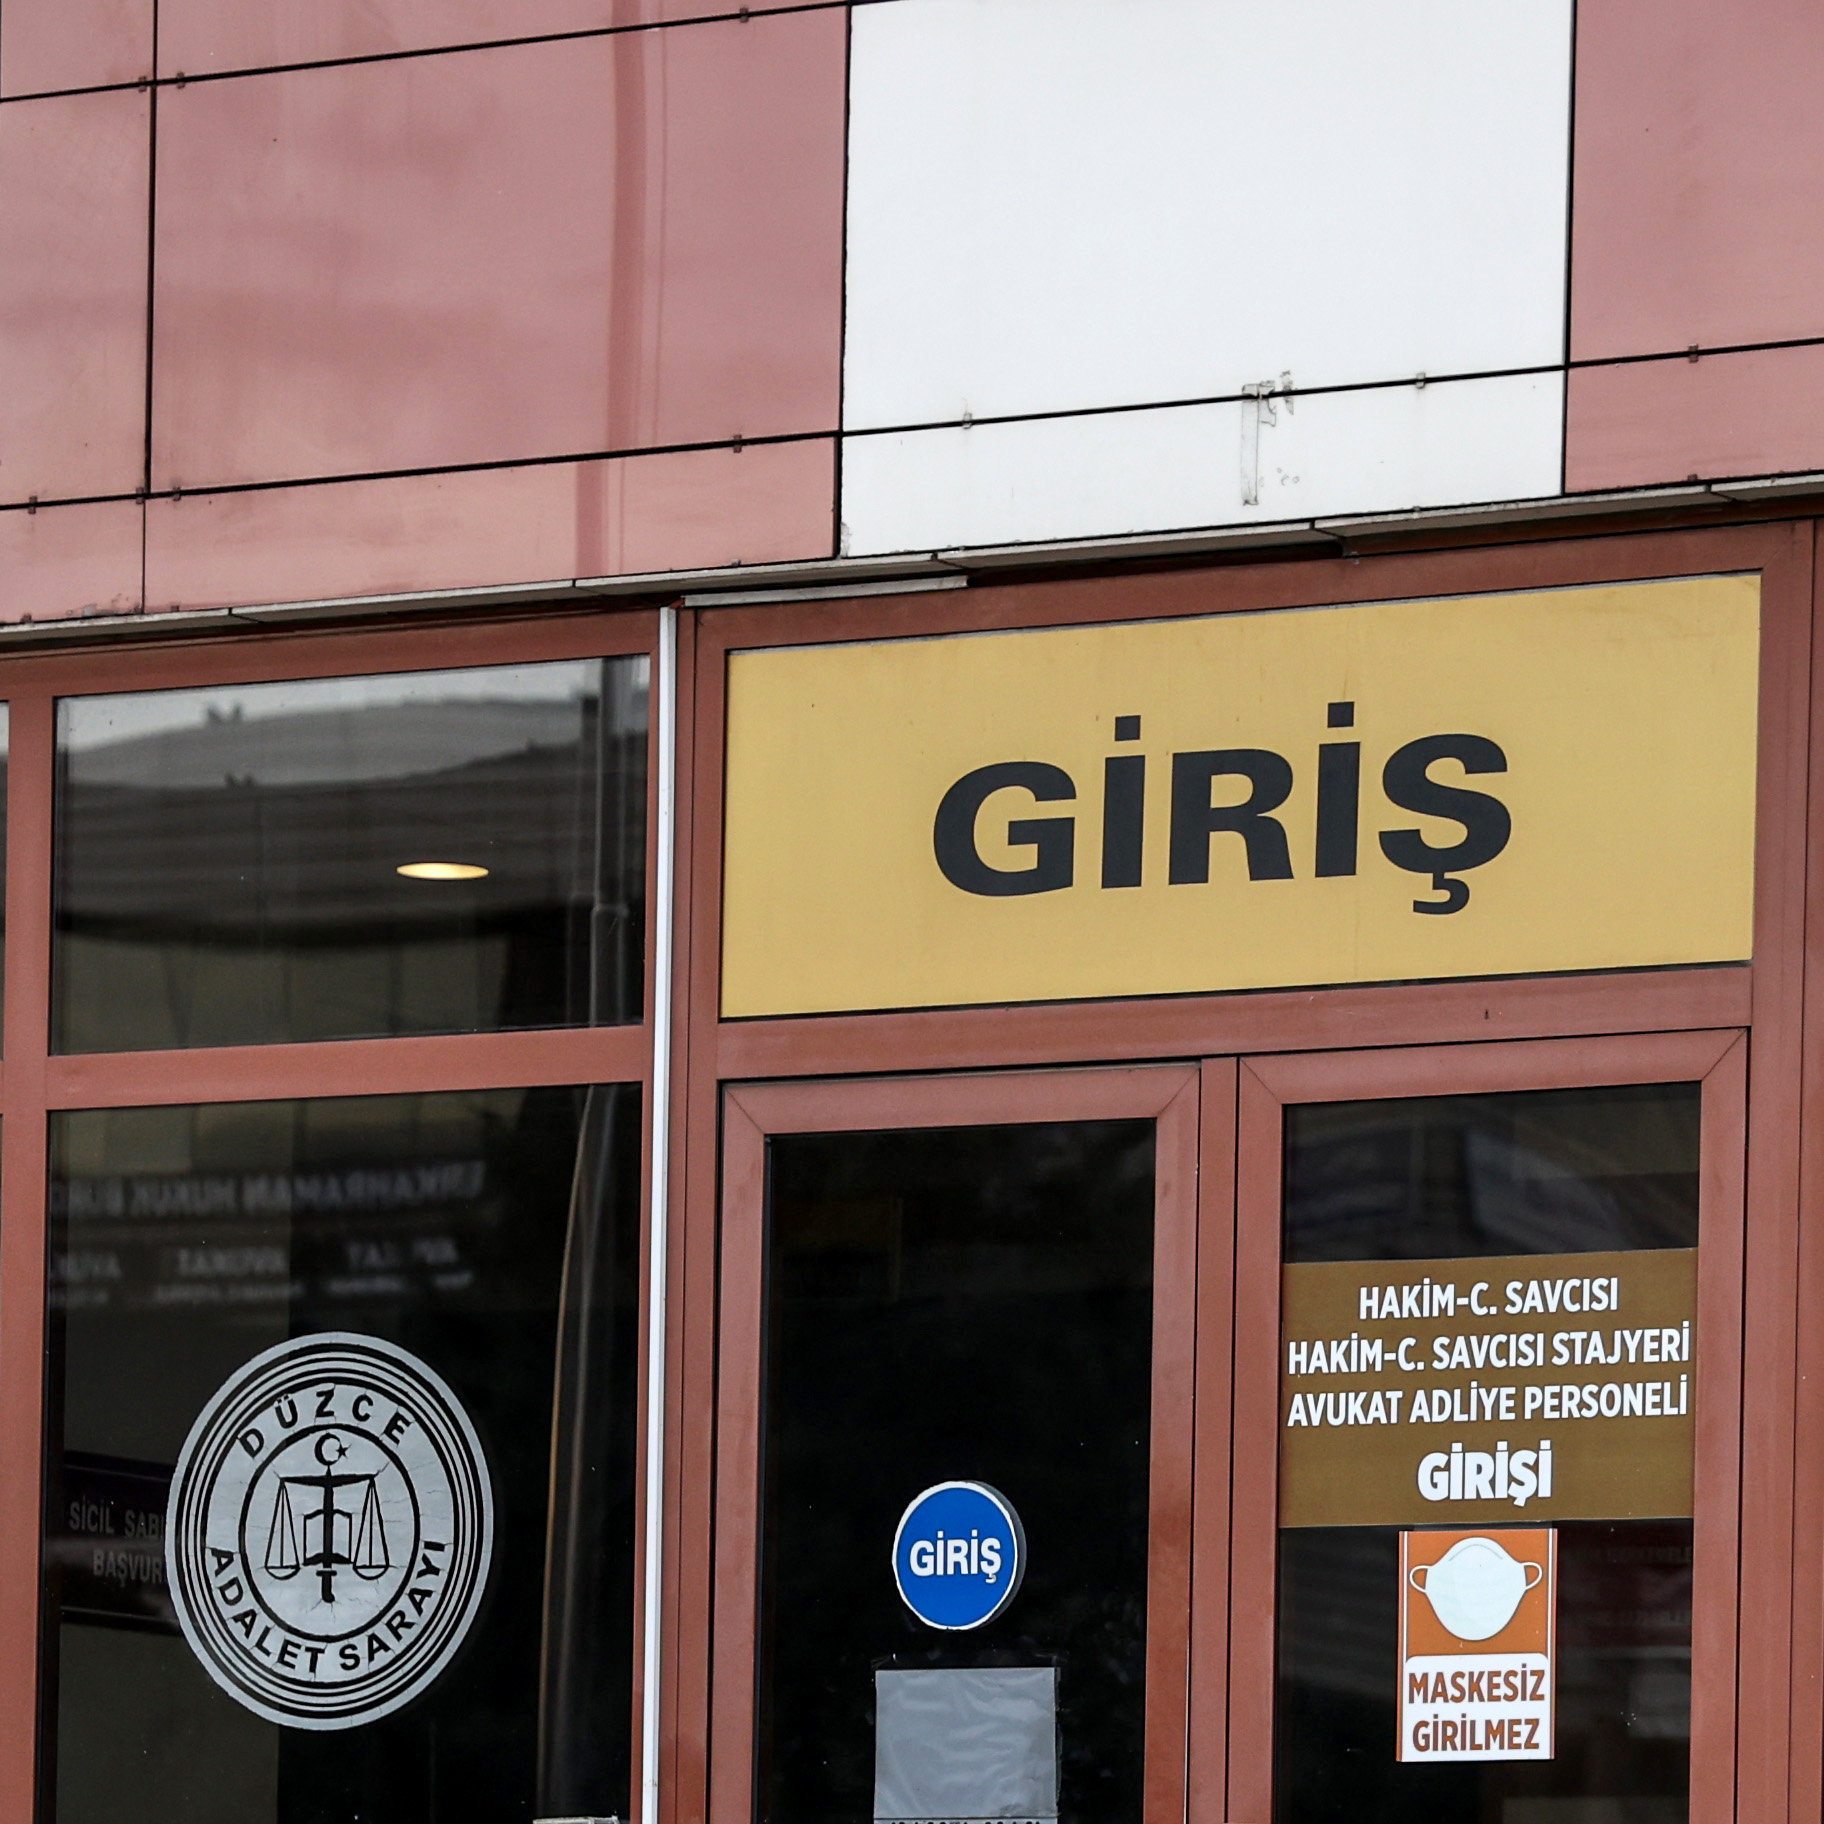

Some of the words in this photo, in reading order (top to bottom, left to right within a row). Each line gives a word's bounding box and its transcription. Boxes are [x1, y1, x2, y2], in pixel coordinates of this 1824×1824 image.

[933, 700, 1512, 915] GİRİŞ
[1359, 1277, 1497, 1320] HAKİM-C.
[1504, 1277, 1619, 1316] SAVCISI
[1288, 1332, 1425, 1375] HAKİM-C.
[1432, 1332, 1545, 1370] SAVCISI
[1551, 1320, 1690, 1367] STAJYERİ
[237, 1388, 417, 1461] DÜZCE
[1287, 1389, 1403, 1428] AVUKAT
[1409, 1381, 1516, 1424] ADLİYE
[1524, 1374, 1688, 1421] PERSONELİ
[1417, 1439, 1553, 1508] GİRİŞİ
[67, 1495, 115, 1535] SİCİL
[909, 1528, 1002, 1584] GİRİŞ
[209, 1547, 324, 1675] ADALET
[338, 1540, 447, 1672] SARAYI
[1408, 1663, 1546, 1704] MASKESİZ
[1412, 1713, 1540, 1753] GİRİLMEZ
